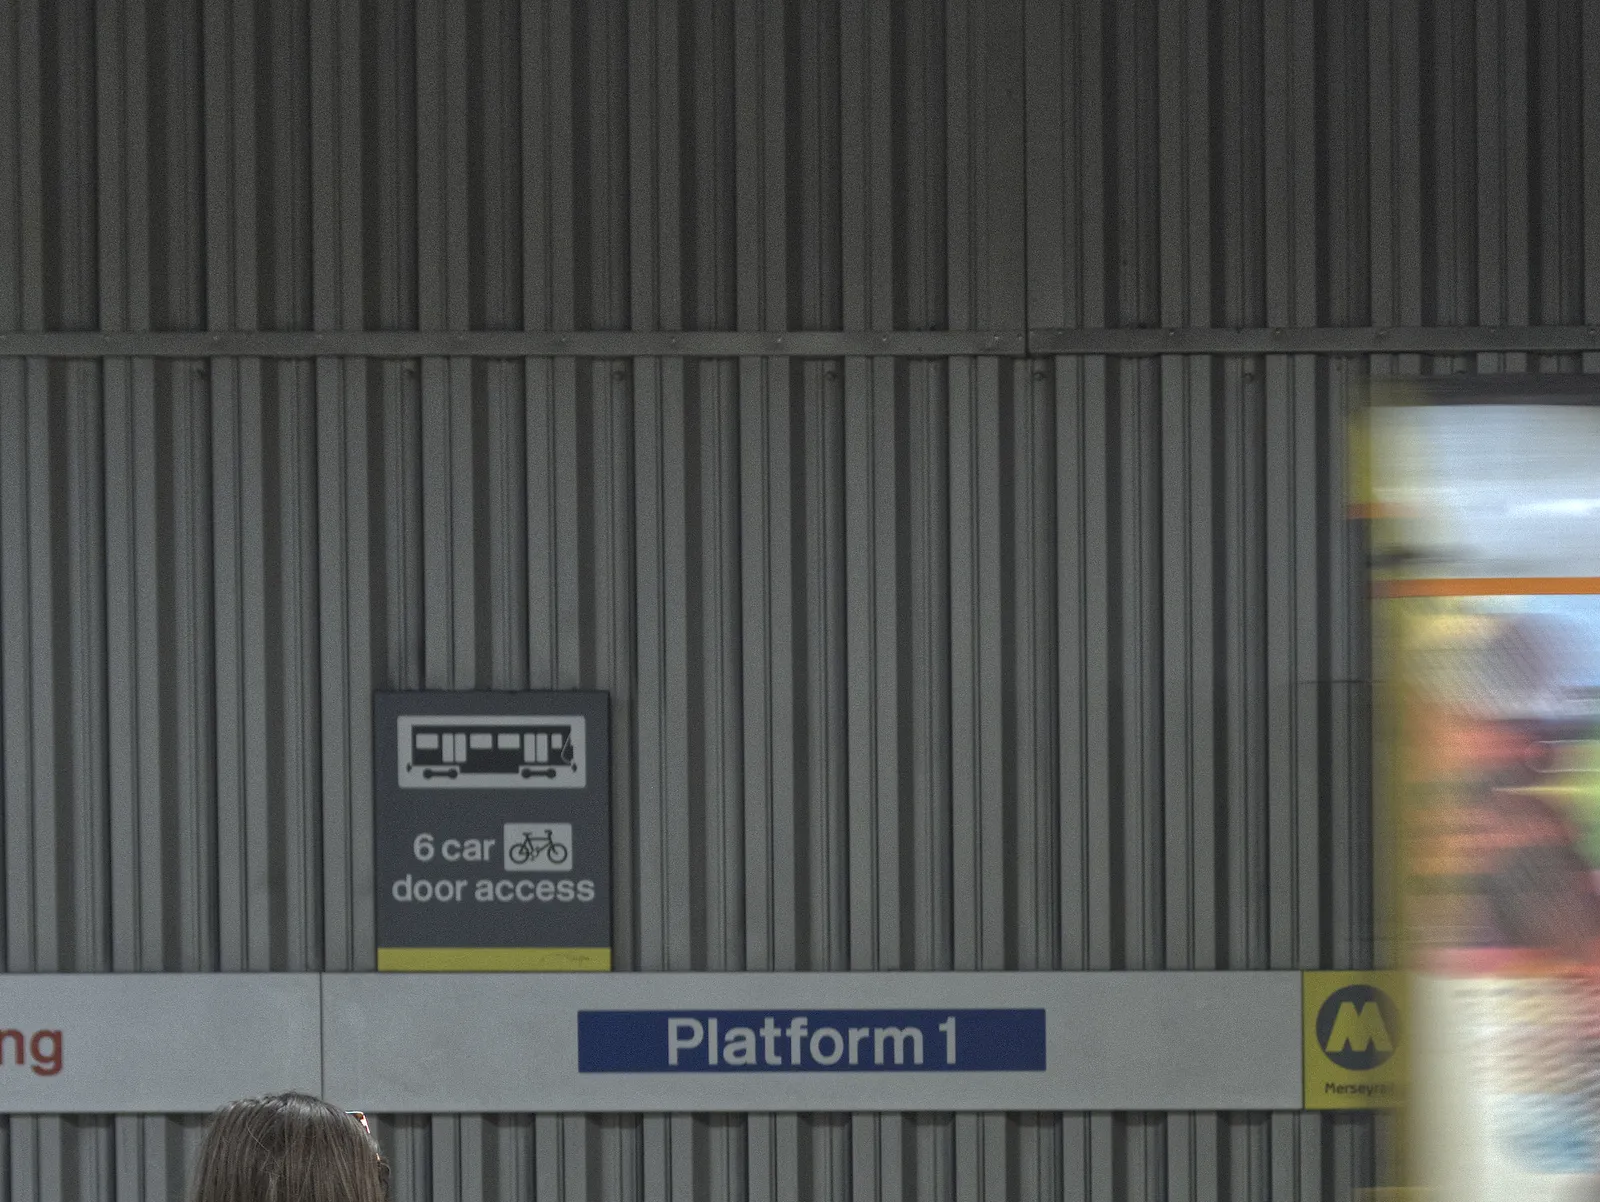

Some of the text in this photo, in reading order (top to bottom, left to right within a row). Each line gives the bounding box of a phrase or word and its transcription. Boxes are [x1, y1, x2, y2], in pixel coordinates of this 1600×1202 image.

[413, 832, 496, 862] 6 car
[391, 873, 595, 902] door access
[667, 1016, 957, 1066] Platform 1
